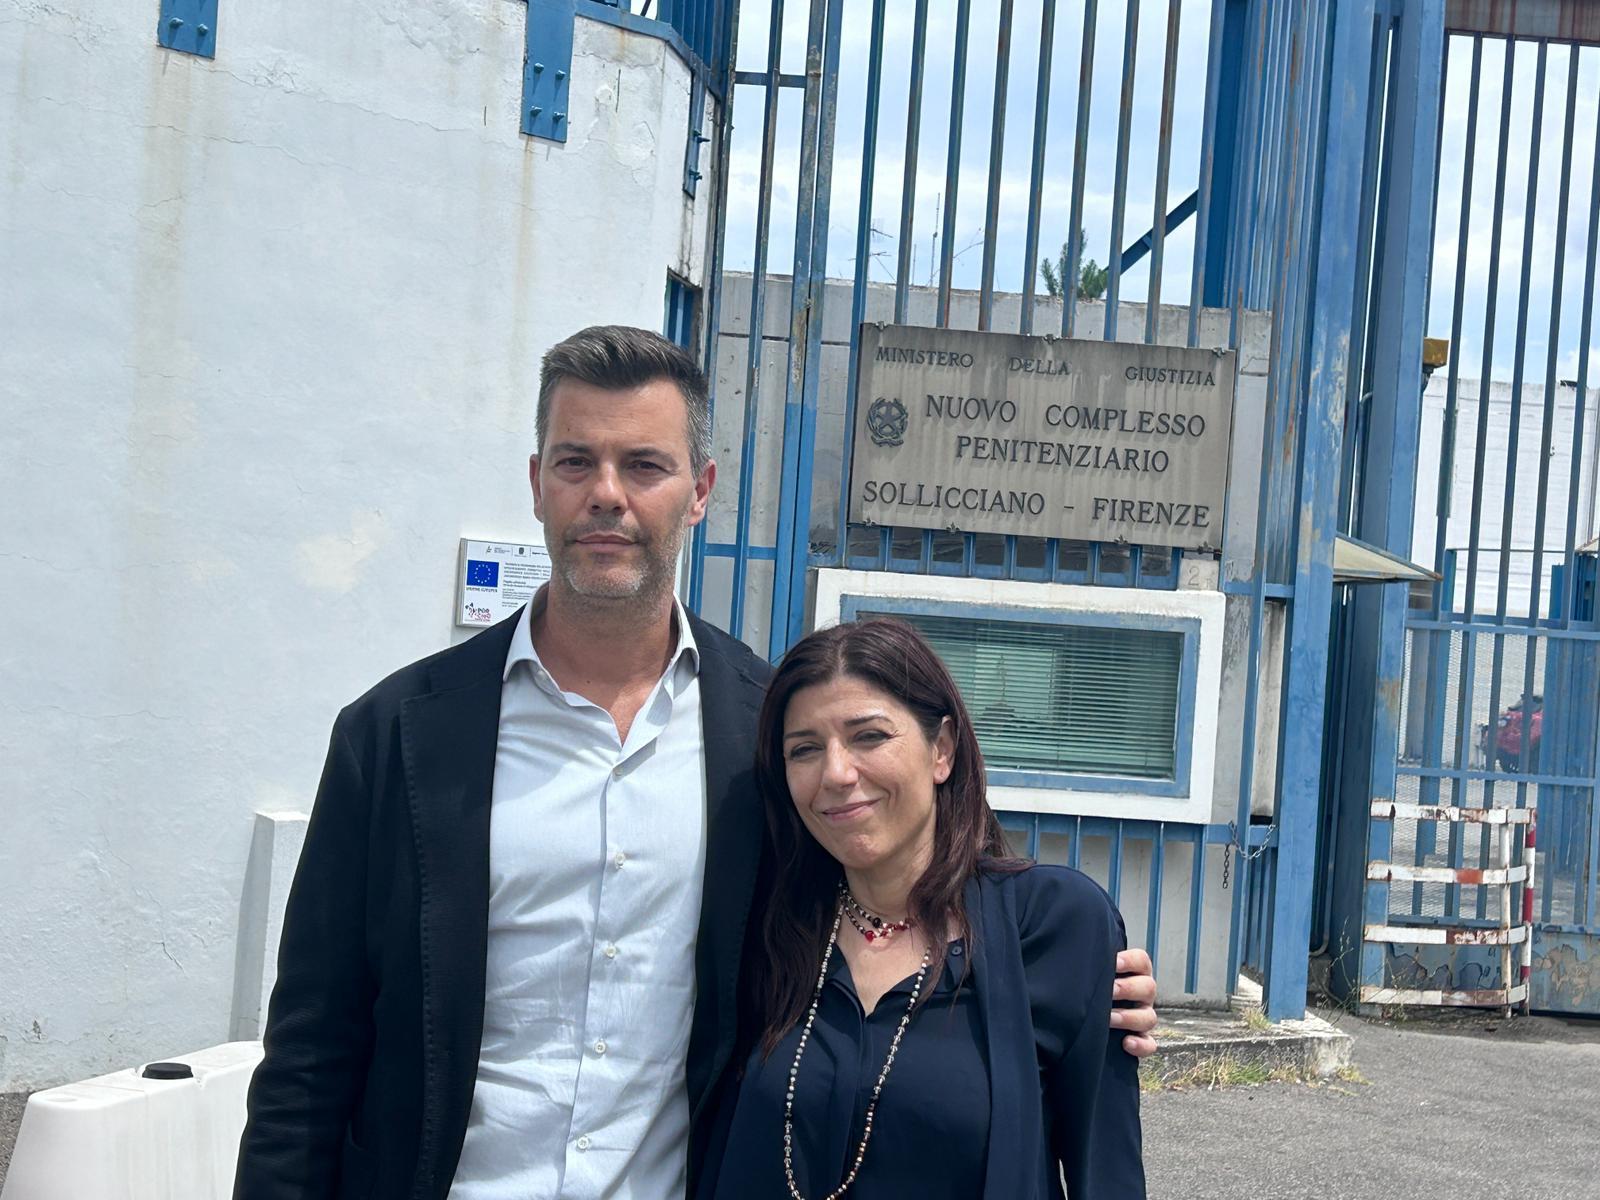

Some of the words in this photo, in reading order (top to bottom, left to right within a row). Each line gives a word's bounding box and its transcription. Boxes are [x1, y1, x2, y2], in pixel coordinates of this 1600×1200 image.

[876, 346, 974, 369] MINISTERO
[1009, 356, 1070, 376] DELLA
[1125, 366, 1215, 387] GIUSTIZIA
[926, 394, 1017, 423] NUOVO
[1045, 404, 1206, 437] COMPLESSO
[956, 435, 1169, 473] PENITENZIARIO
[863, 480, 1045, 515] SOLLICCIANO
[1092, 497, 1210, 528] FIRENZE
